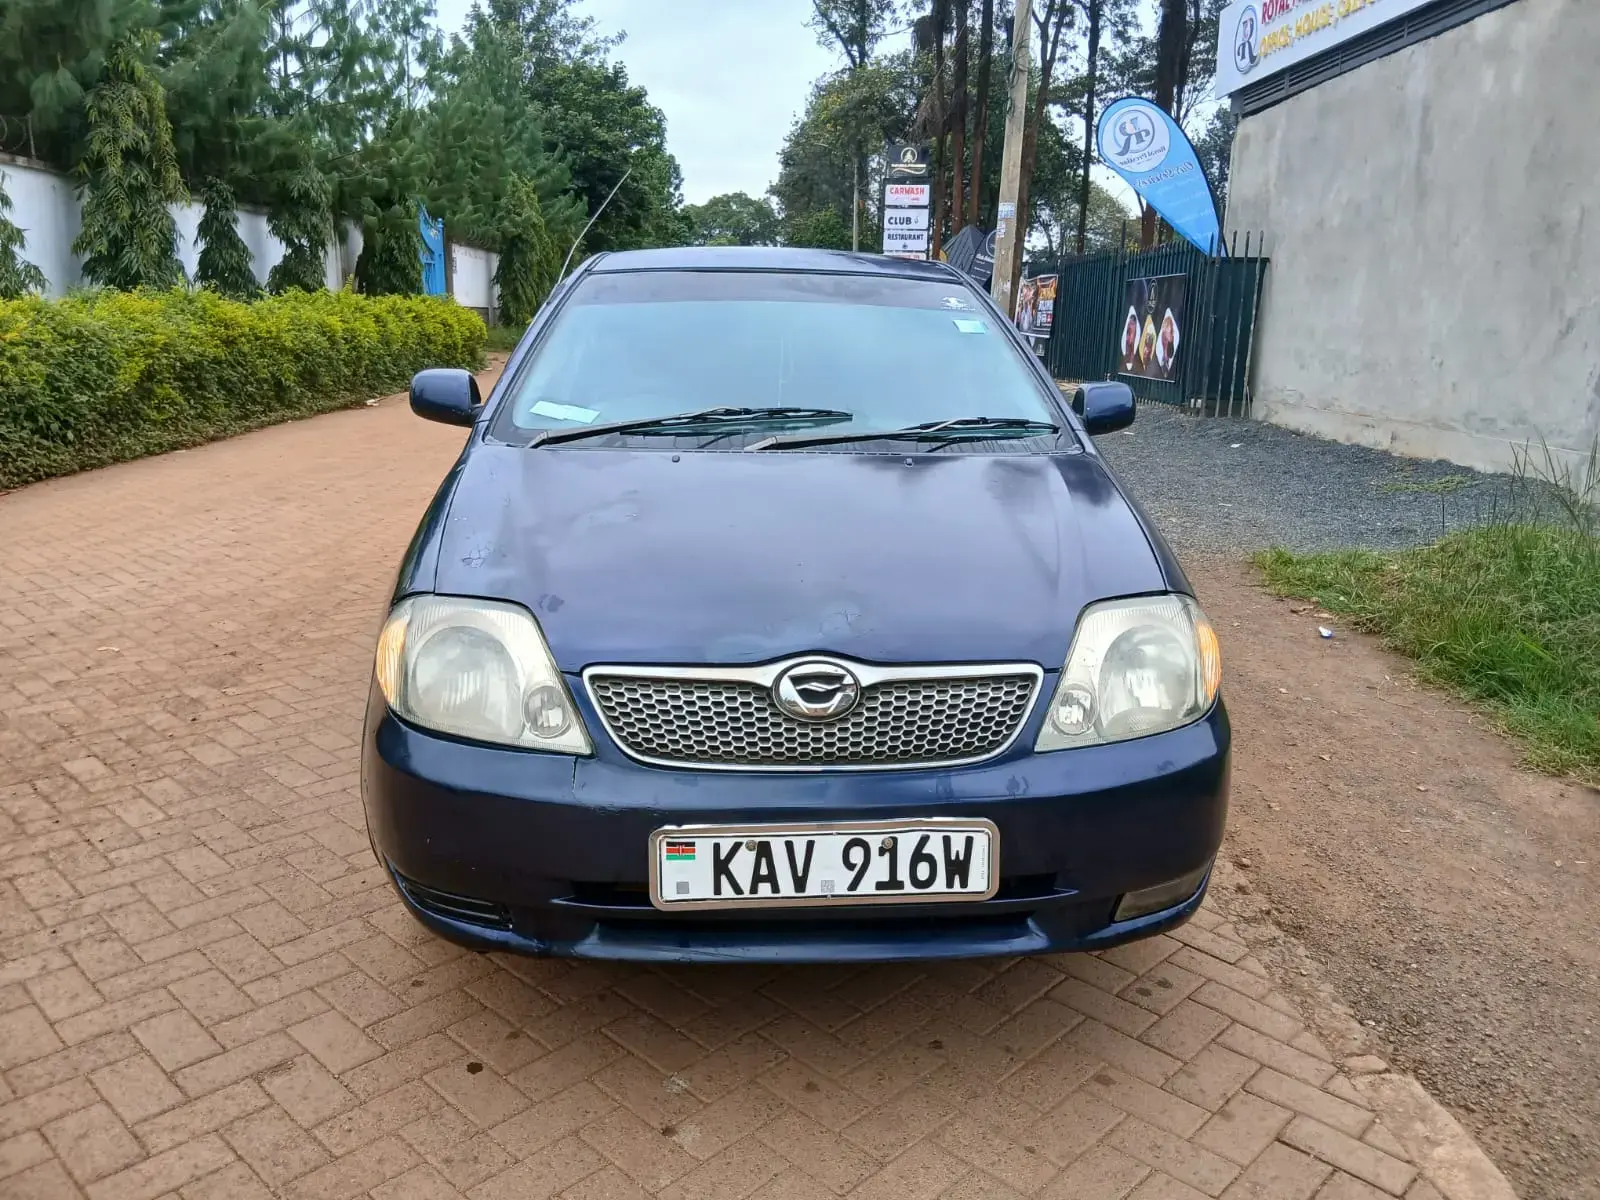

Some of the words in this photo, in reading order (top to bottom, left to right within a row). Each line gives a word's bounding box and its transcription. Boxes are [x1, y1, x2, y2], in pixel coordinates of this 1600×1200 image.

[889, 187, 925, 195] CARWASH
[888, 216, 912, 225] CLUB
[712, 840, 815, 895] KAV
[841, 834, 974, 892] 916W
